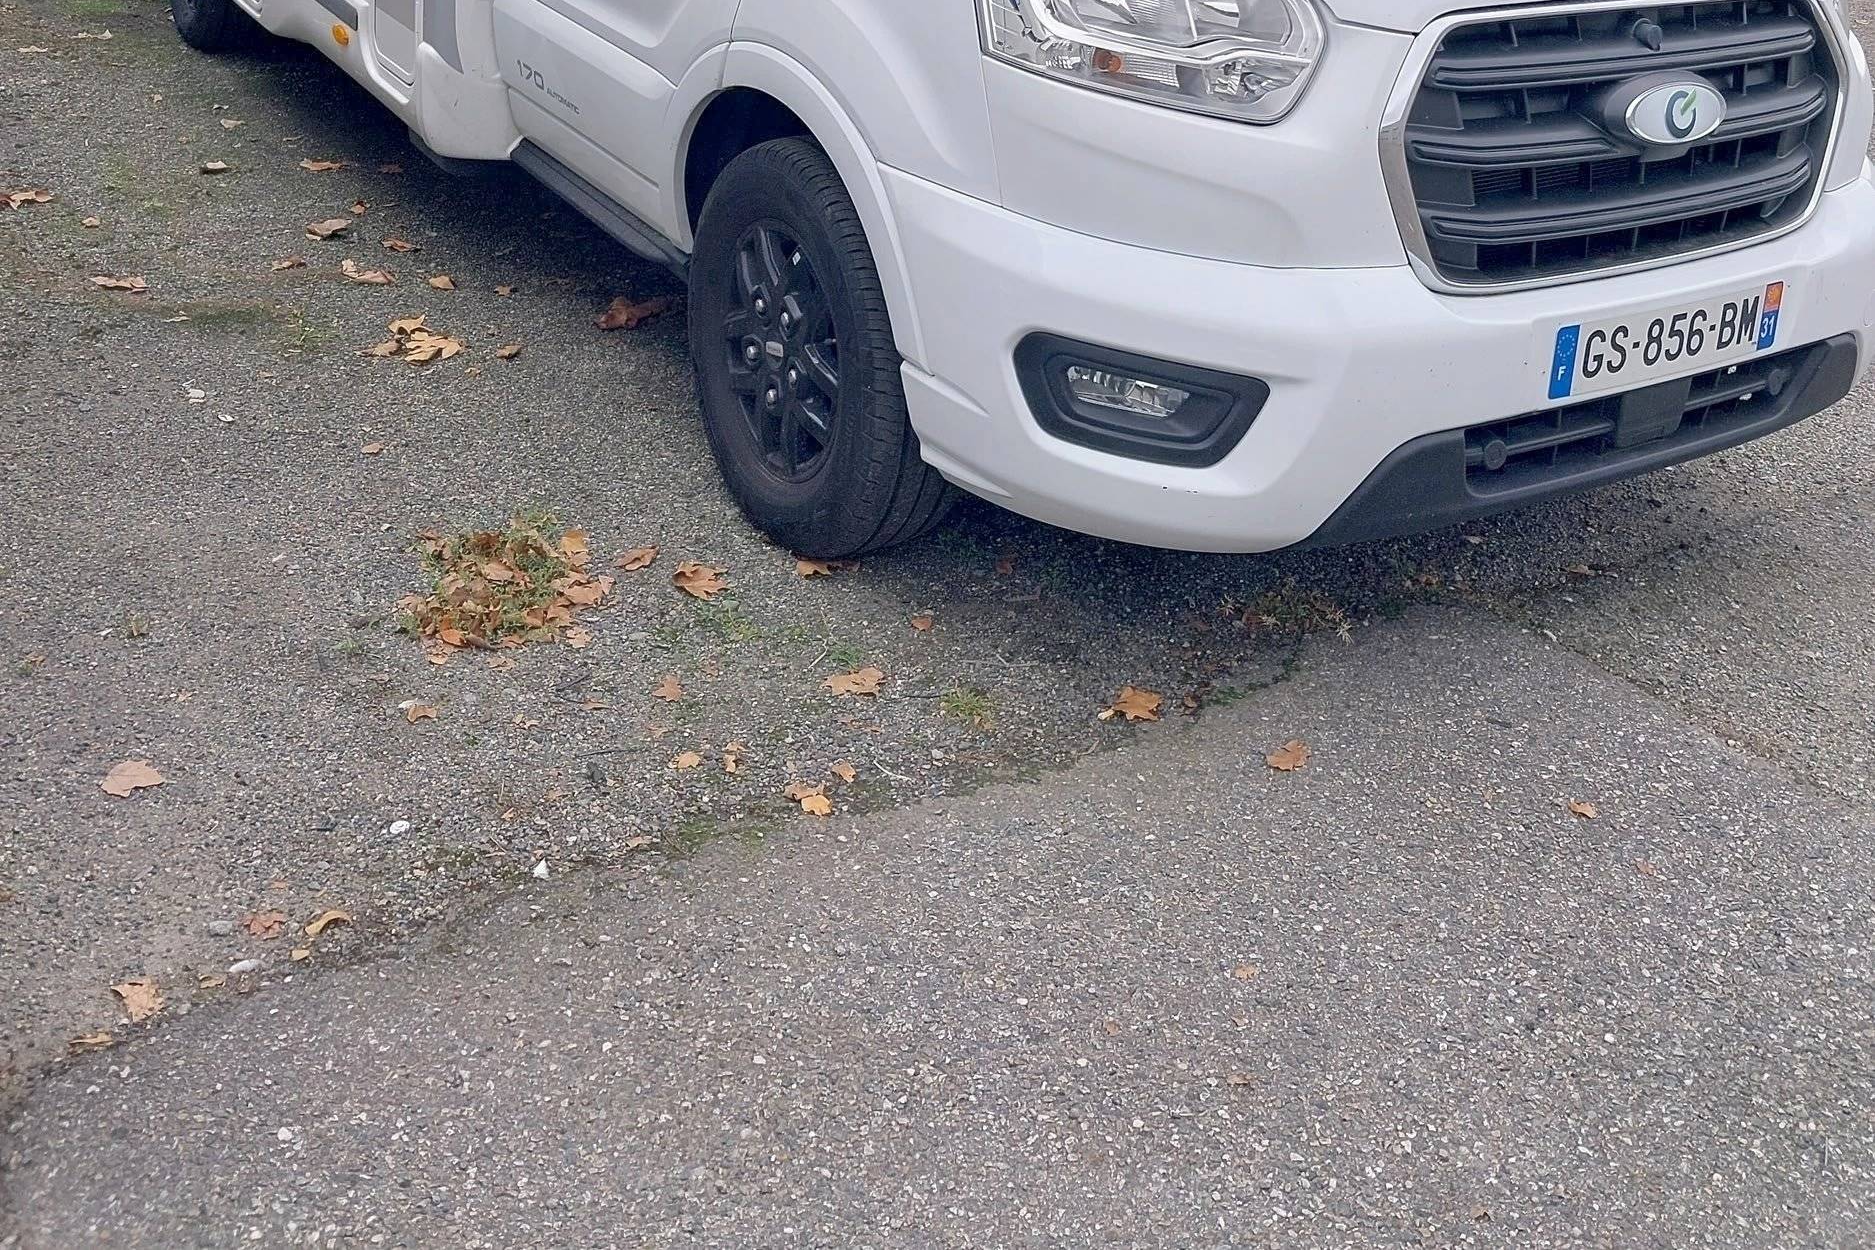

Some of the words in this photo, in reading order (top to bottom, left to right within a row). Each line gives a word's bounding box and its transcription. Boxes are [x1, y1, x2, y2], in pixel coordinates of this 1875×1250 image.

[516, 59, 545, 91] 170
[1557, 365, 1566, 381] F
[1582, 295, 1760, 379] GS-856-BM
[1761, 317, 1775, 339] 31
